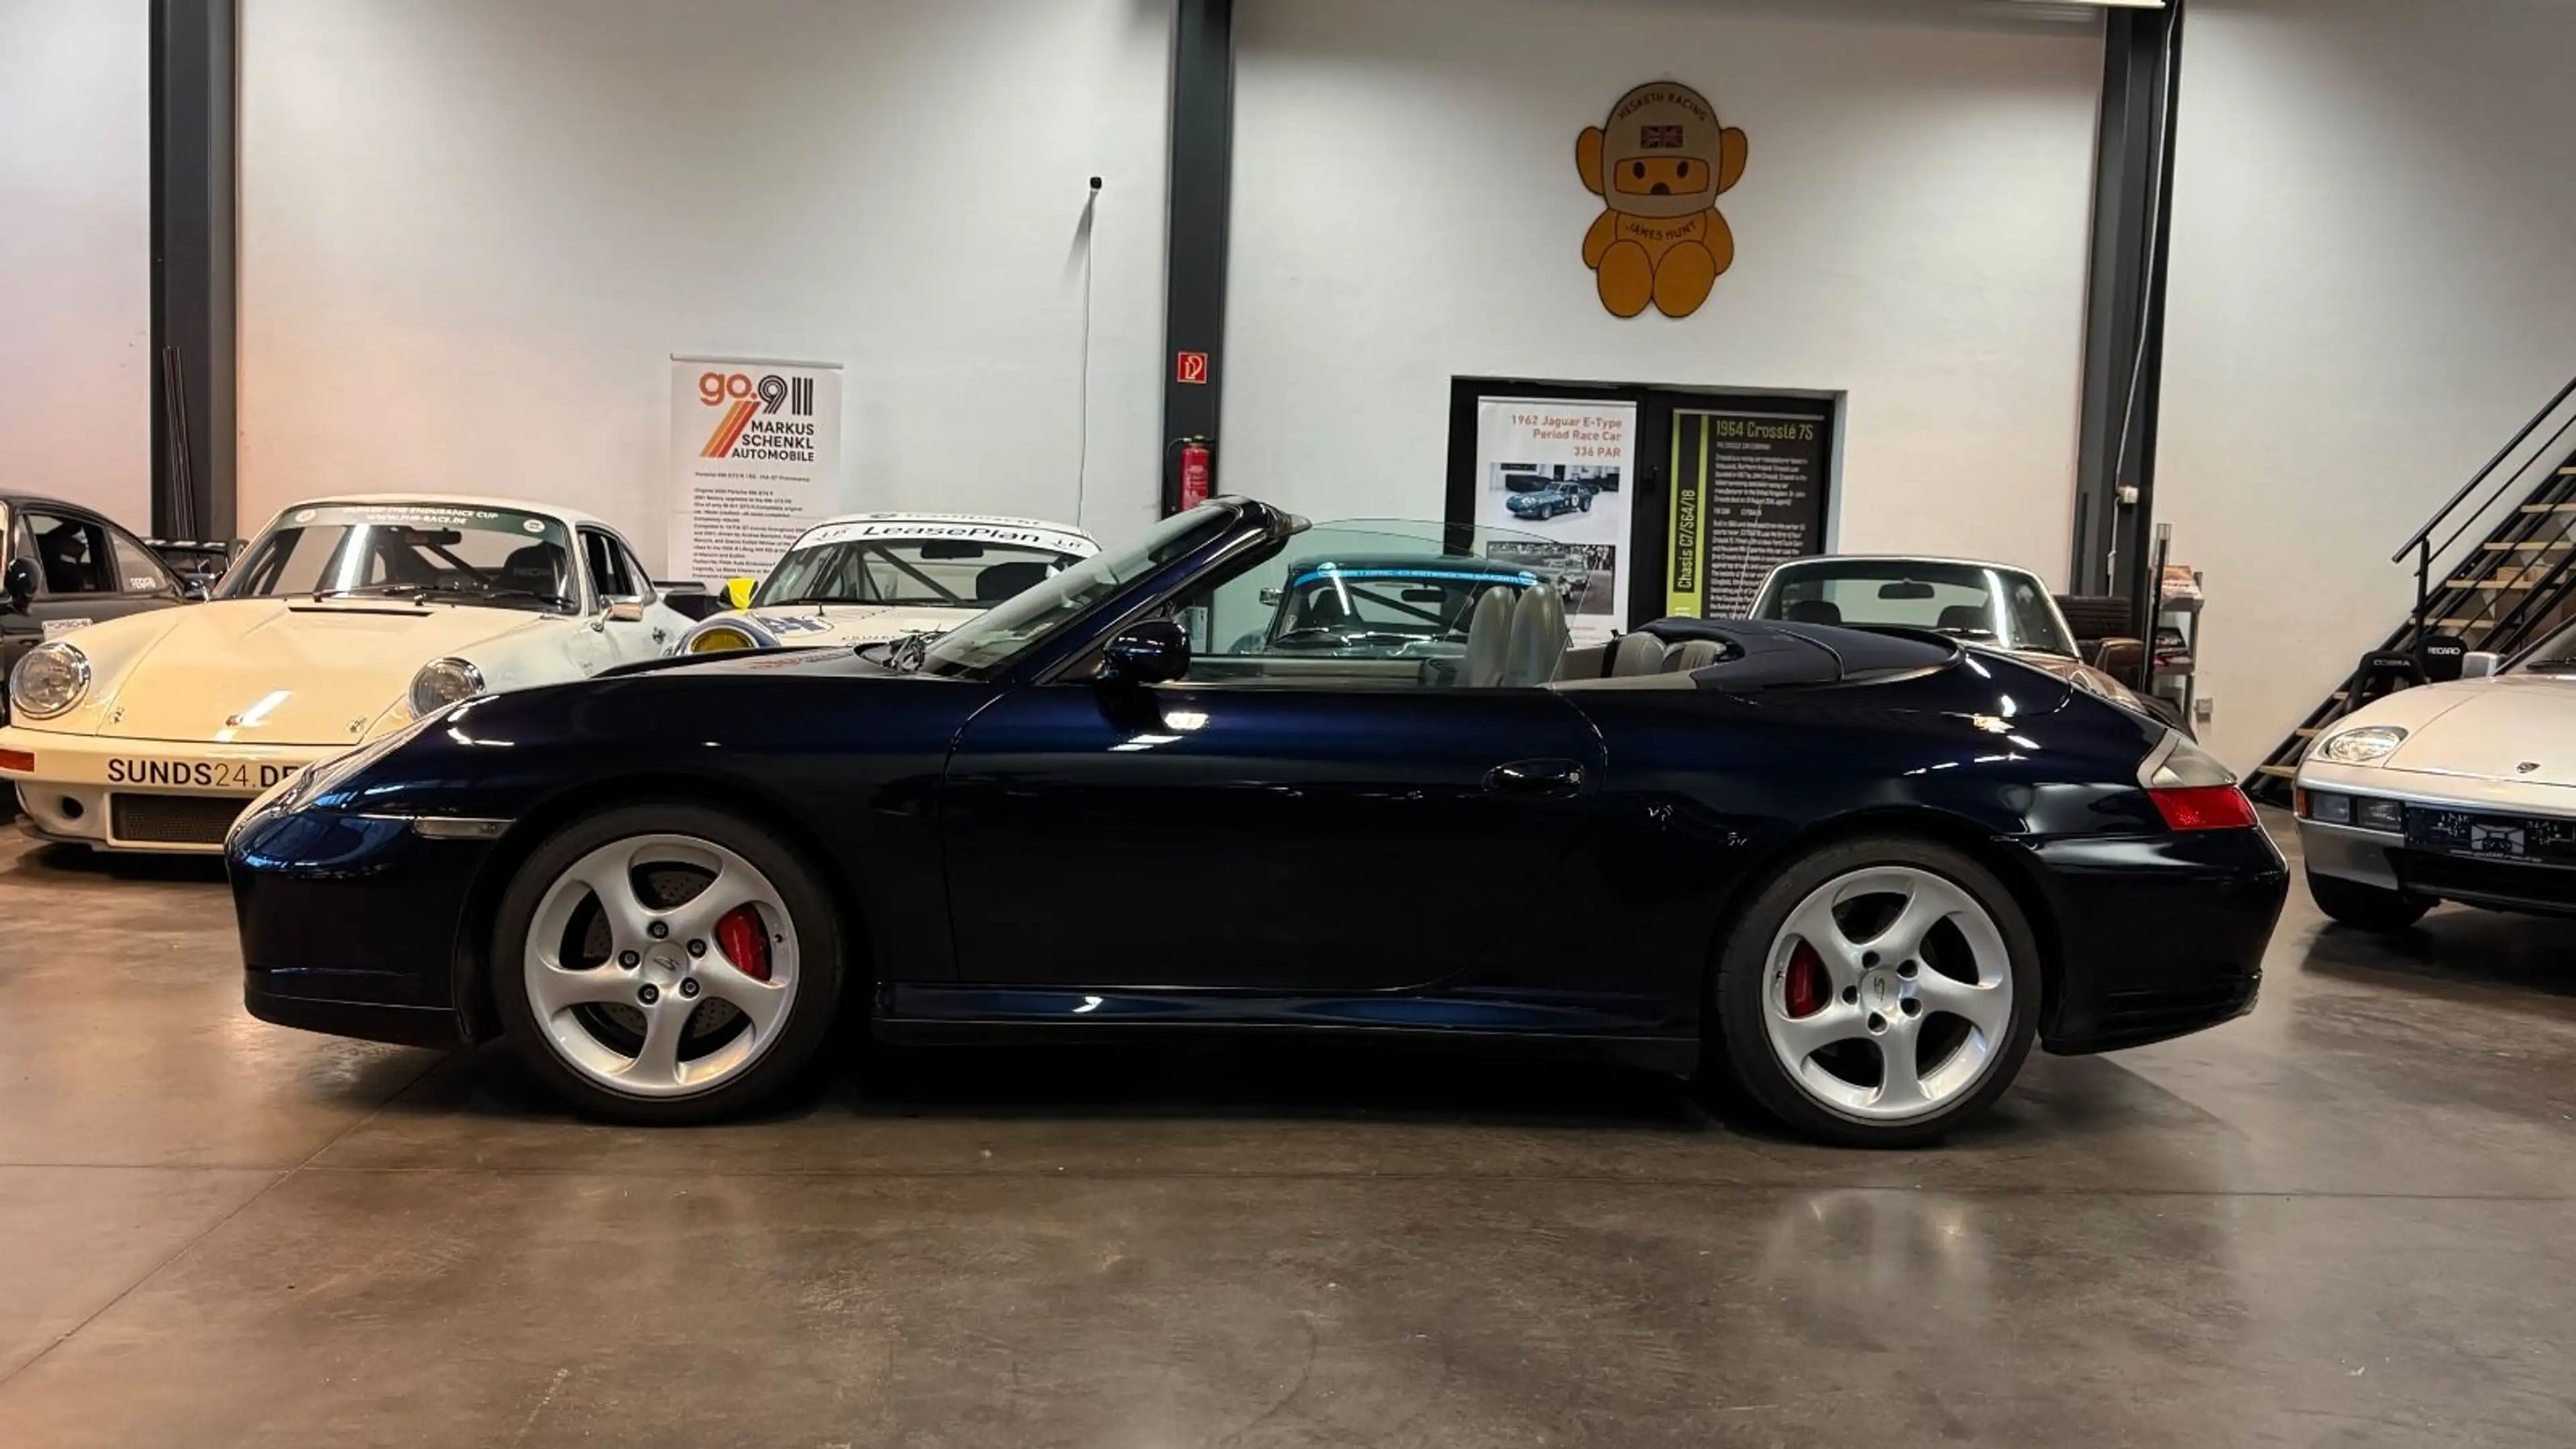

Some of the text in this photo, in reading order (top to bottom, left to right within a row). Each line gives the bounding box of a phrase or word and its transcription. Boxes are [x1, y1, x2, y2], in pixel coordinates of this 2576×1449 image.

[1625, 219, 1697, 240] JAMES HUNT
[751, 420, 814, 435] MARKUS
[1512, 415, 1623, 430] 1962 Jaguar E-Type
[741, 434, 814, 449] SCHENKL
[1533, 428, 1621, 441] Period Race Car
[731, 447, 814, 462] AUTOMOBILE
[1574, 446, 1621, 458] 336 PAR
[476, 511, 499, 520] CUP
[863, 526, 1040, 543] LeasePlan
[2427, 646, 2461, 655] RECARO
